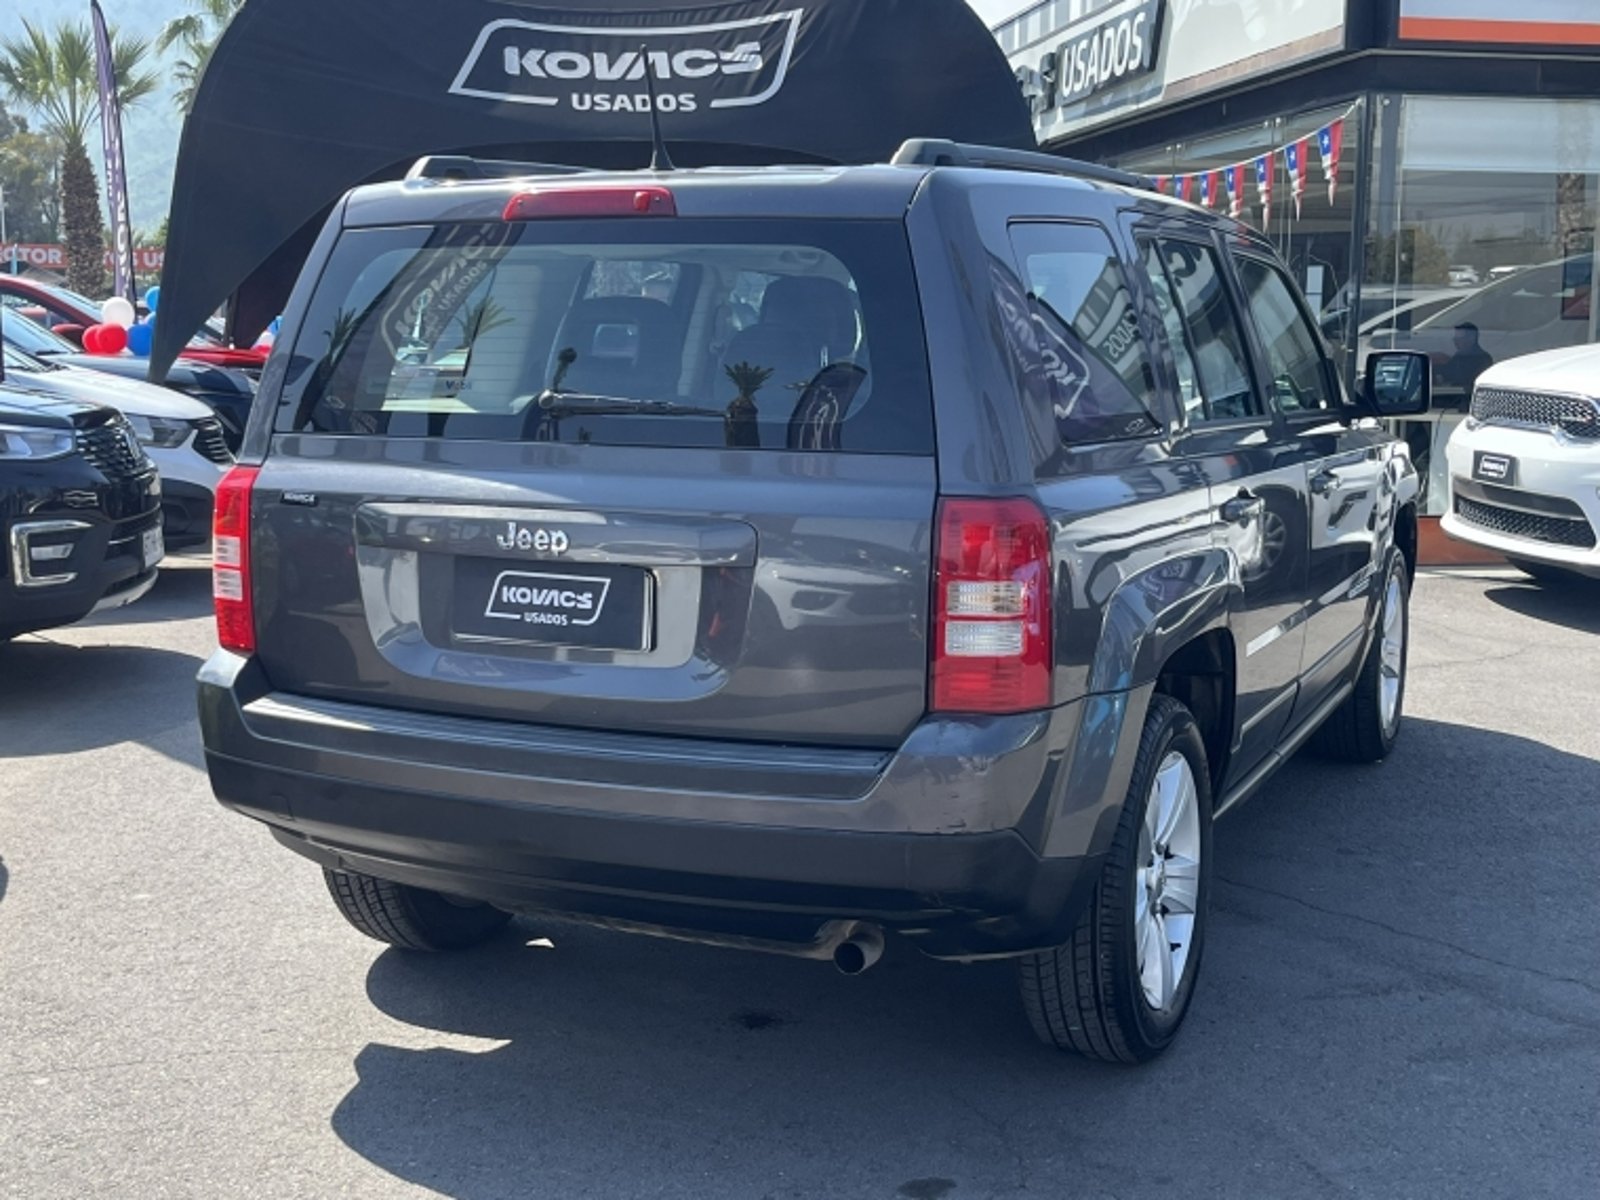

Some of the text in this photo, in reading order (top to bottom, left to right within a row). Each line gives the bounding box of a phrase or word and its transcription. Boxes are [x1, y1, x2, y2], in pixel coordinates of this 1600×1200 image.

[504, 42, 763, 80] KOVACS
[1062, 12, 1146, 97] USADOS
[571, 93, 697, 112] USADOS
[0, 247, 62, 264] OTOR
[497, 521, 569, 557] Jeep
[502, 585, 594, 611] KOVACS
[524, 610, 568, 627] USADOS
